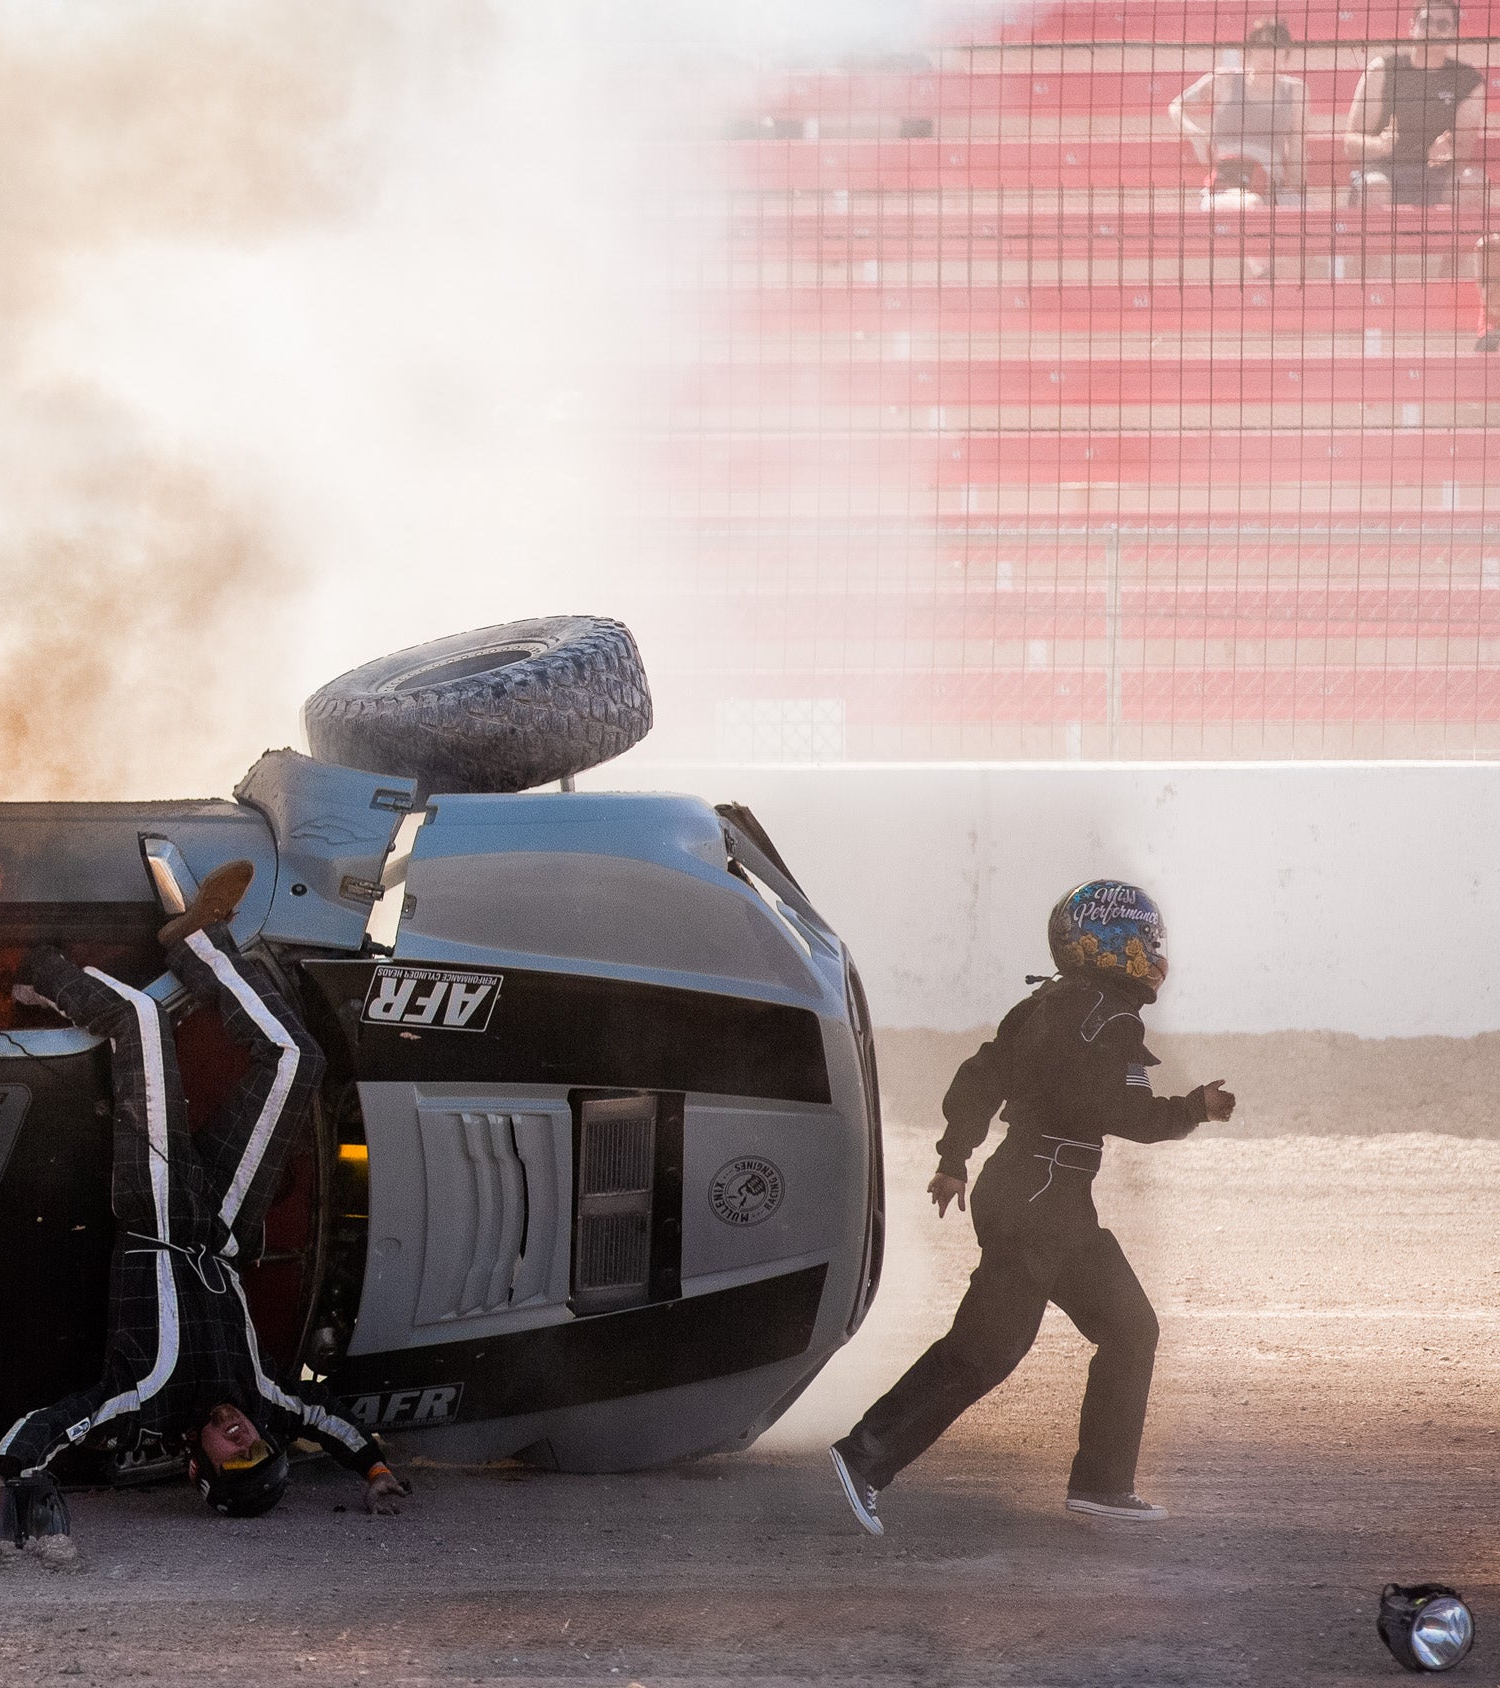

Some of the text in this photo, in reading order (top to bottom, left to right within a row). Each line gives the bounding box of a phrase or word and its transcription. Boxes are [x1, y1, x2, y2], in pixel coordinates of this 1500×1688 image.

[1094, 885, 1136, 905] Miss
[1073, 901, 1159, 928] Performance
[377, 967, 498, 986] PERFORMANCE CYLINDER HEADS
[367, 977, 493, 1027] AFR
[713, 1181, 749, 1223] MULLENIX
[734, 1160, 779, 1212] RACING ENGINES
[350, 1387, 457, 1424] AFR
